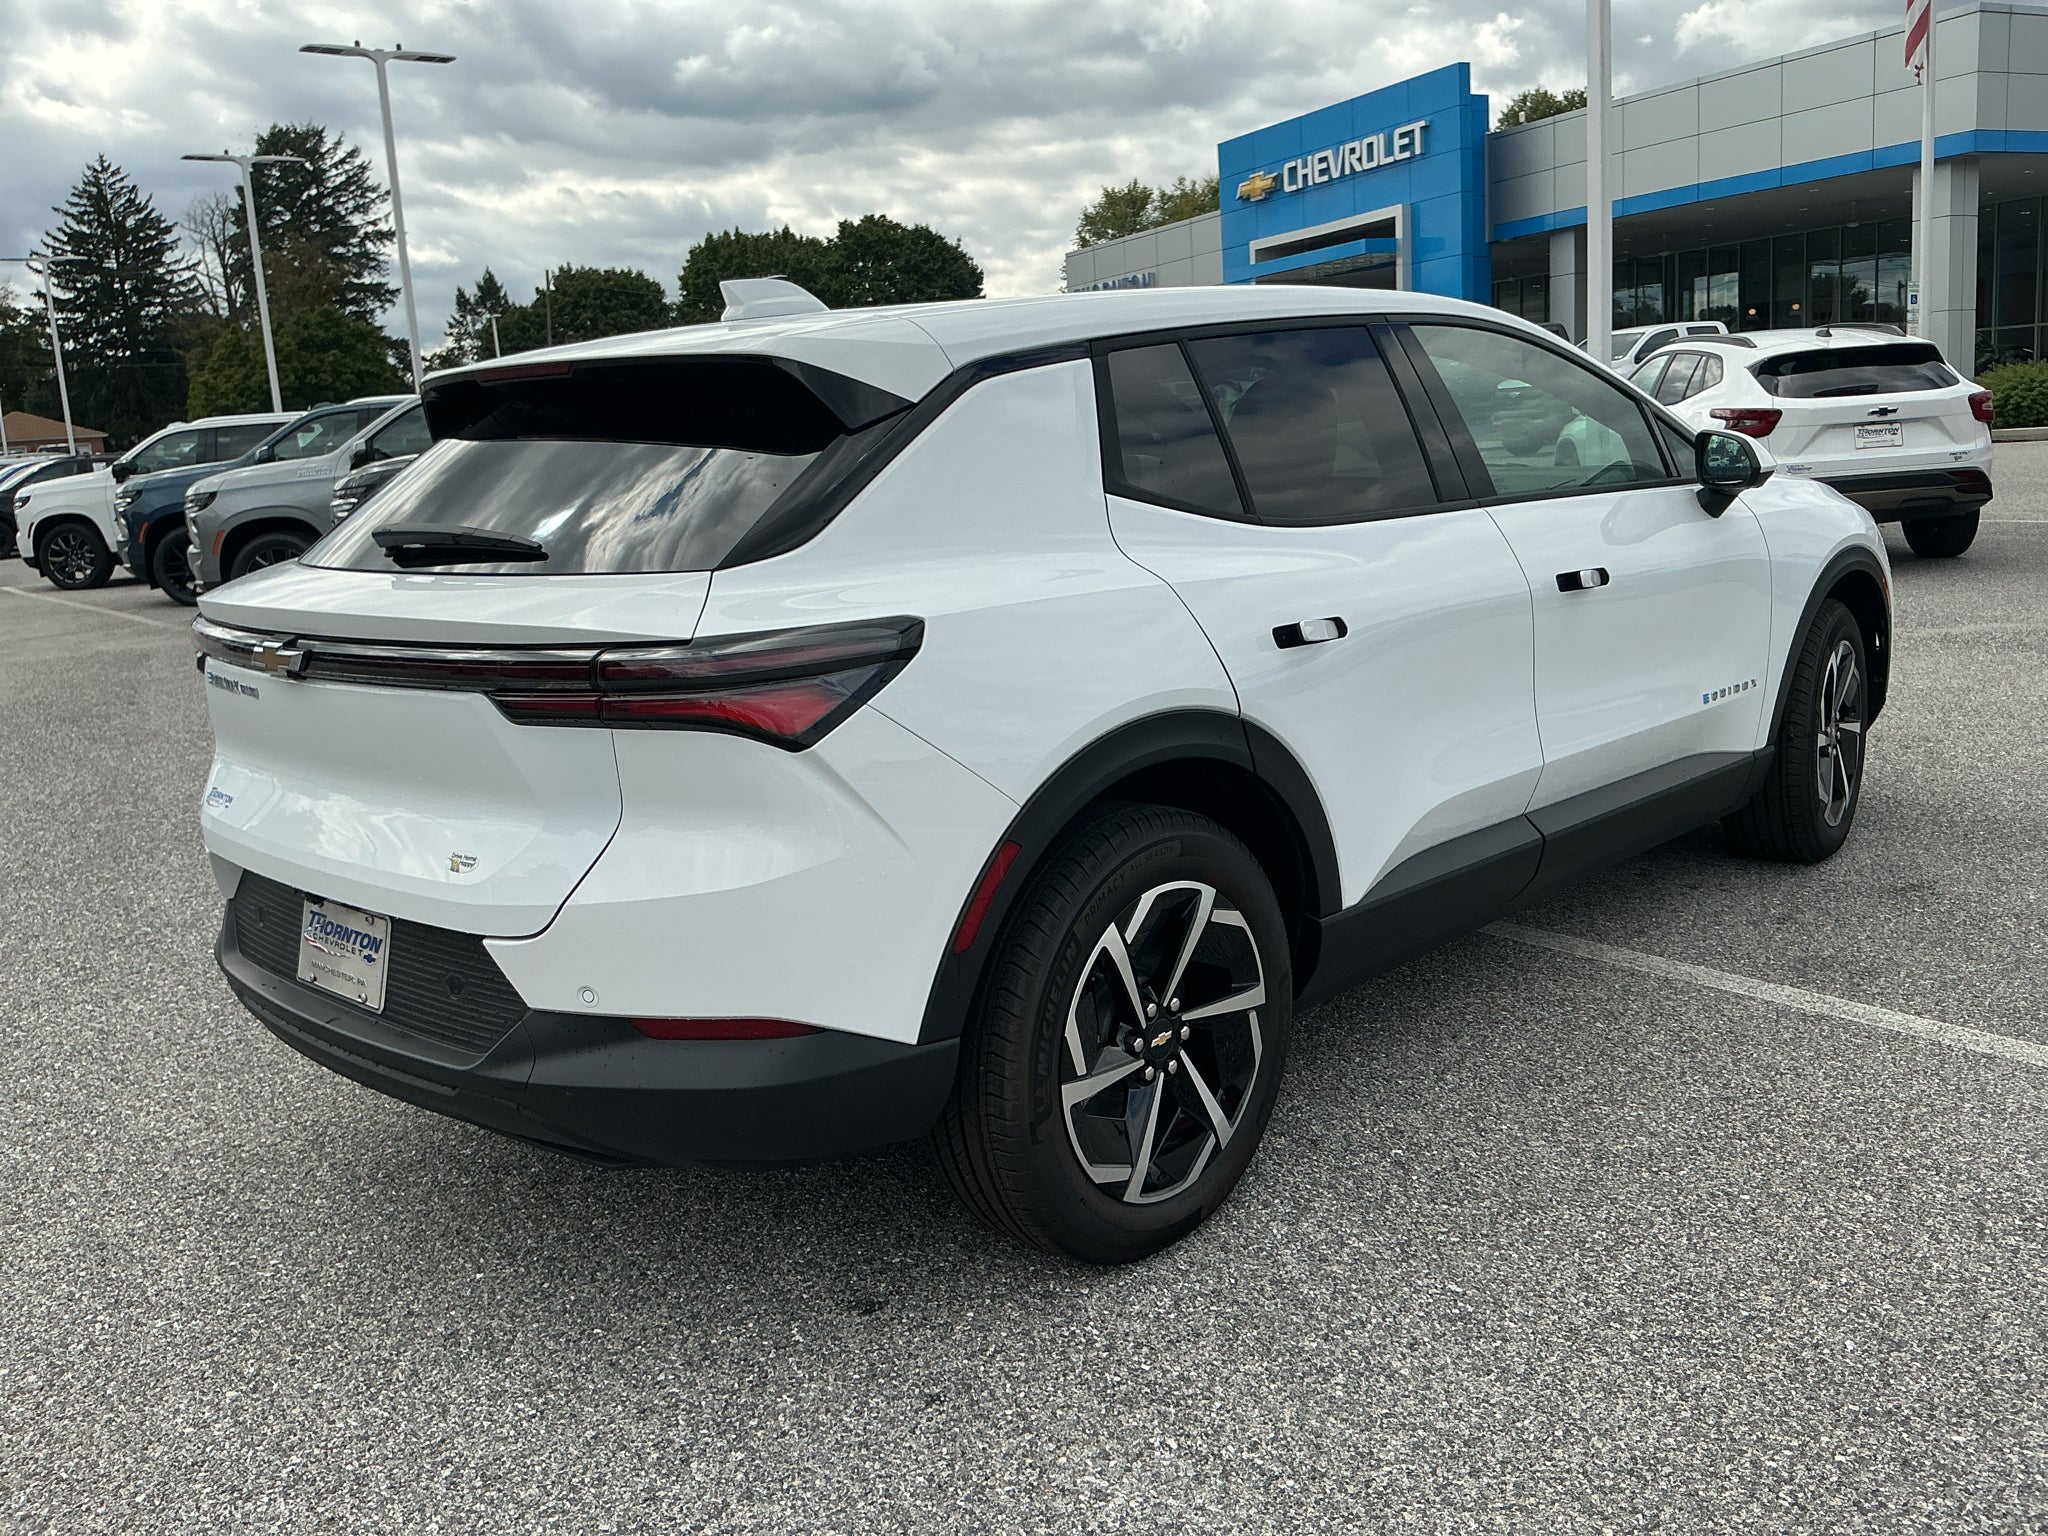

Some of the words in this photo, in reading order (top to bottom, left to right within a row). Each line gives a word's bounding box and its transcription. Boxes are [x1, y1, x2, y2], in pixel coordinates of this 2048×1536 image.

[1283, 120, 1427, 192] CHEVROLET
[1084, 871, 1126, 926] PRIMACY
[309, 910, 383, 954] THORNTON
[313, 932, 364, 957] CHEVROLET
[1037, 939, 1081, 1077] MICHELIN
